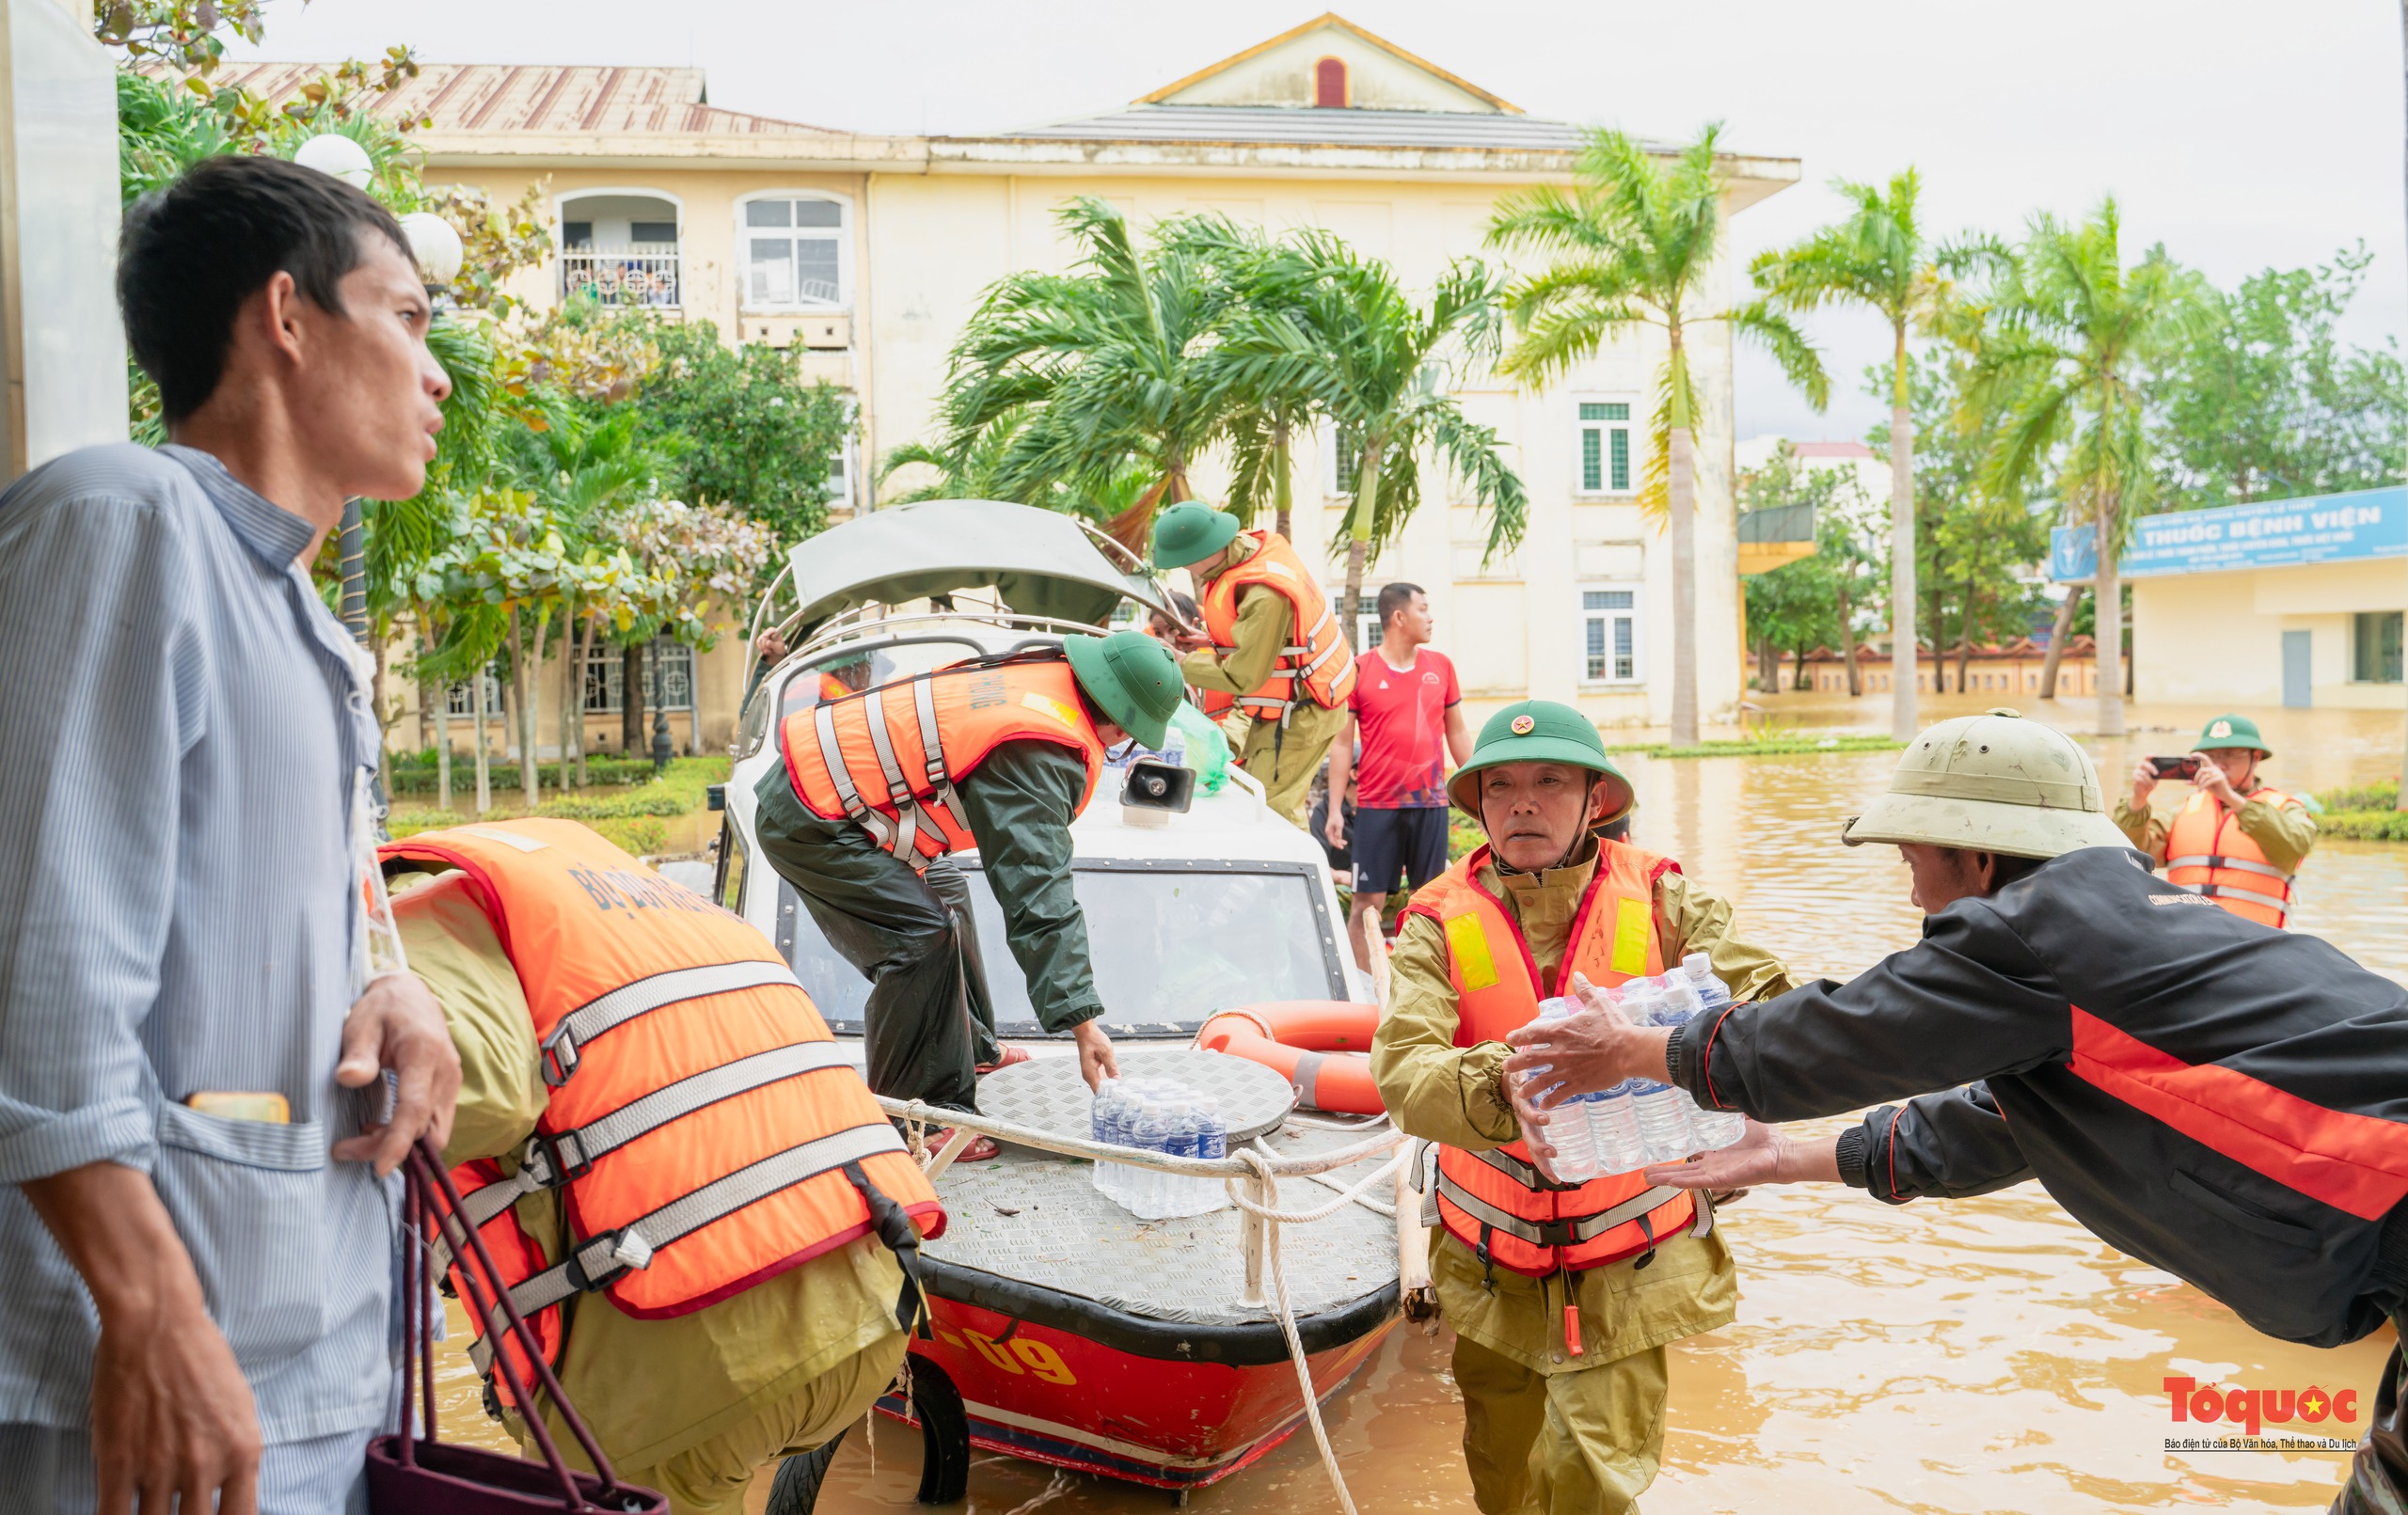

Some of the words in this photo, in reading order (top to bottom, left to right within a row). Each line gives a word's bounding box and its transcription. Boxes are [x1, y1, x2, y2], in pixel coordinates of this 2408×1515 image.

[2144, 521, 2223, 546] THUỐC
[2229, 513, 2305, 539] BỆNH
[2310, 504, 2383, 529] VIỆN
